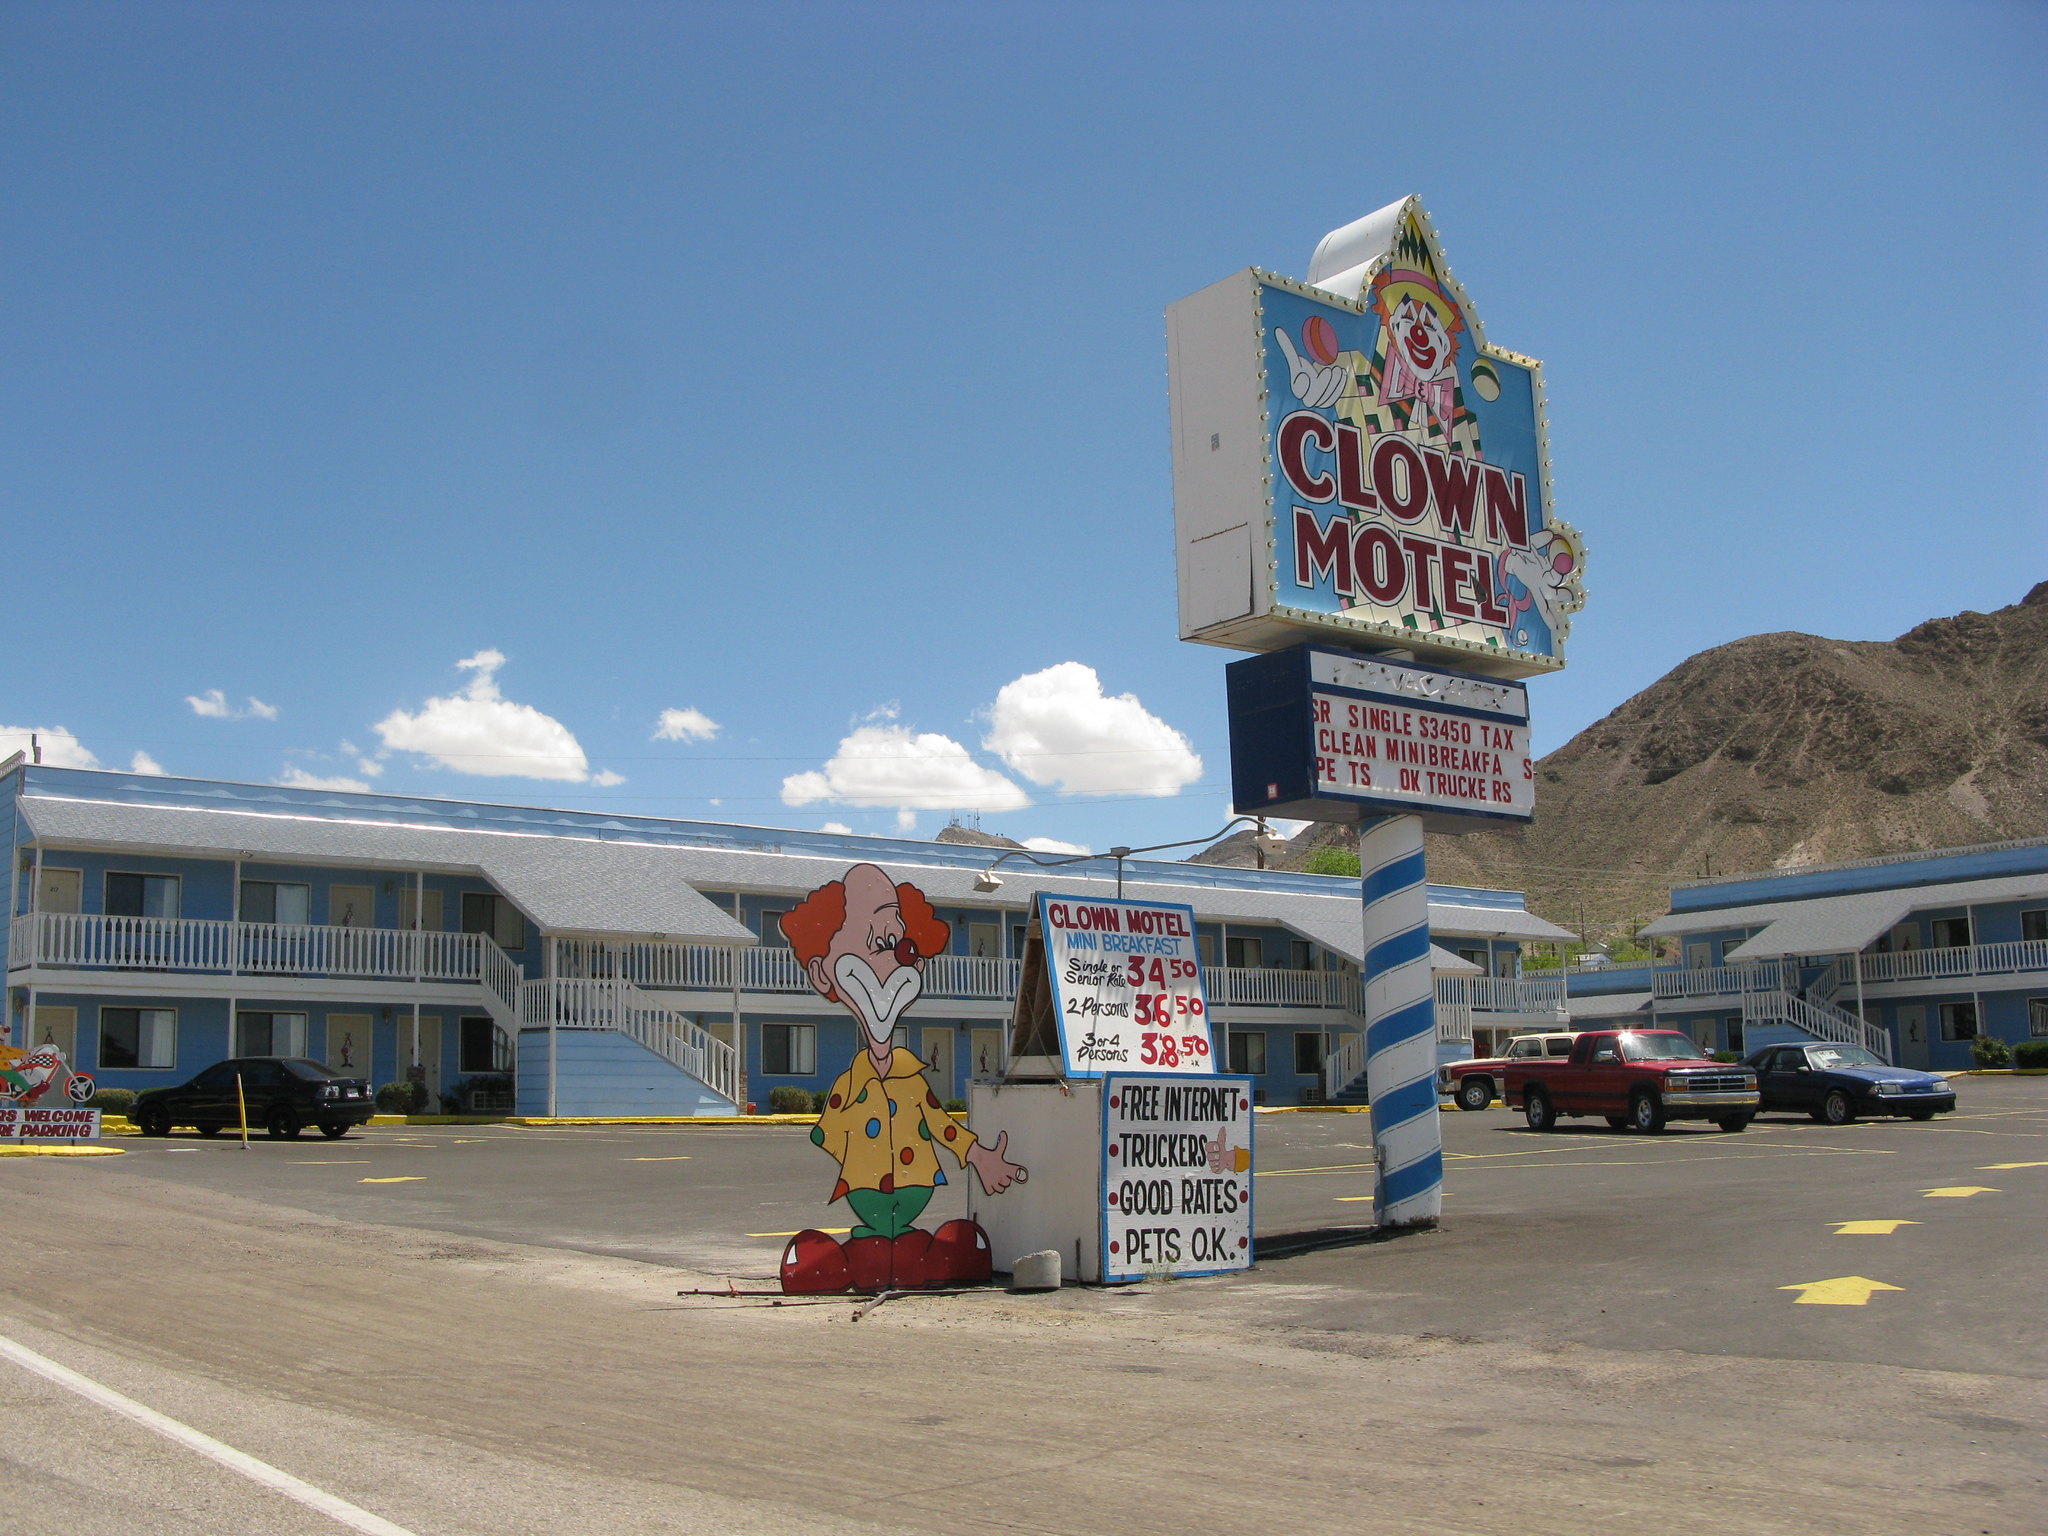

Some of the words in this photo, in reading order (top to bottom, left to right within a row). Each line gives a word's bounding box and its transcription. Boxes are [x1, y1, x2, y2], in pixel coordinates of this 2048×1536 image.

[1277, 410, 1530, 551] CLOWN
[1292, 505, 1510, 629] MOTEL
[1348, 705, 1412, 735] SINGLE
[1481, 725, 1513, 751] TAX
[1320, 729, 1376, 758] CLEAN
[1523, 758, 1532, 779] S
[1400, 768, 1421, 792] OK
[1049, 904, 1120, 932] CLOWN
[1126, 909, 1190, 937] MOTEL
[1066, 932, 1097, 950] MINI
[1102, 933, 1182, 955] BREAKFAST
[1064, 971, 1105, 986] Senior
[1107, 972, 1127, 988] Rate
[1069, 958, 1108, 974] Single
[1066, 998, 1081, 1014] 2
[1081, 997, 1129, 1018] Persons
[1077, 1046, 1129, 1062] Persons
[24, 1110, 95, 1122] WELCOME
[1120, 1085, 1160, 1121] FREE
[1164, 1086, 1240, 1121] INTERNET
[20, 1124, 92, 1137] PARKING
[1119, 1133, 1208, 1168] TRUCKERS
[1119, 1180, 1173, 1216] GOOD
[1181, 1179, 1238, 1214] RATES
[1126, 1228, 1181, 1264] PETS
[1192, 1227, 1236, 1262] O.K.
